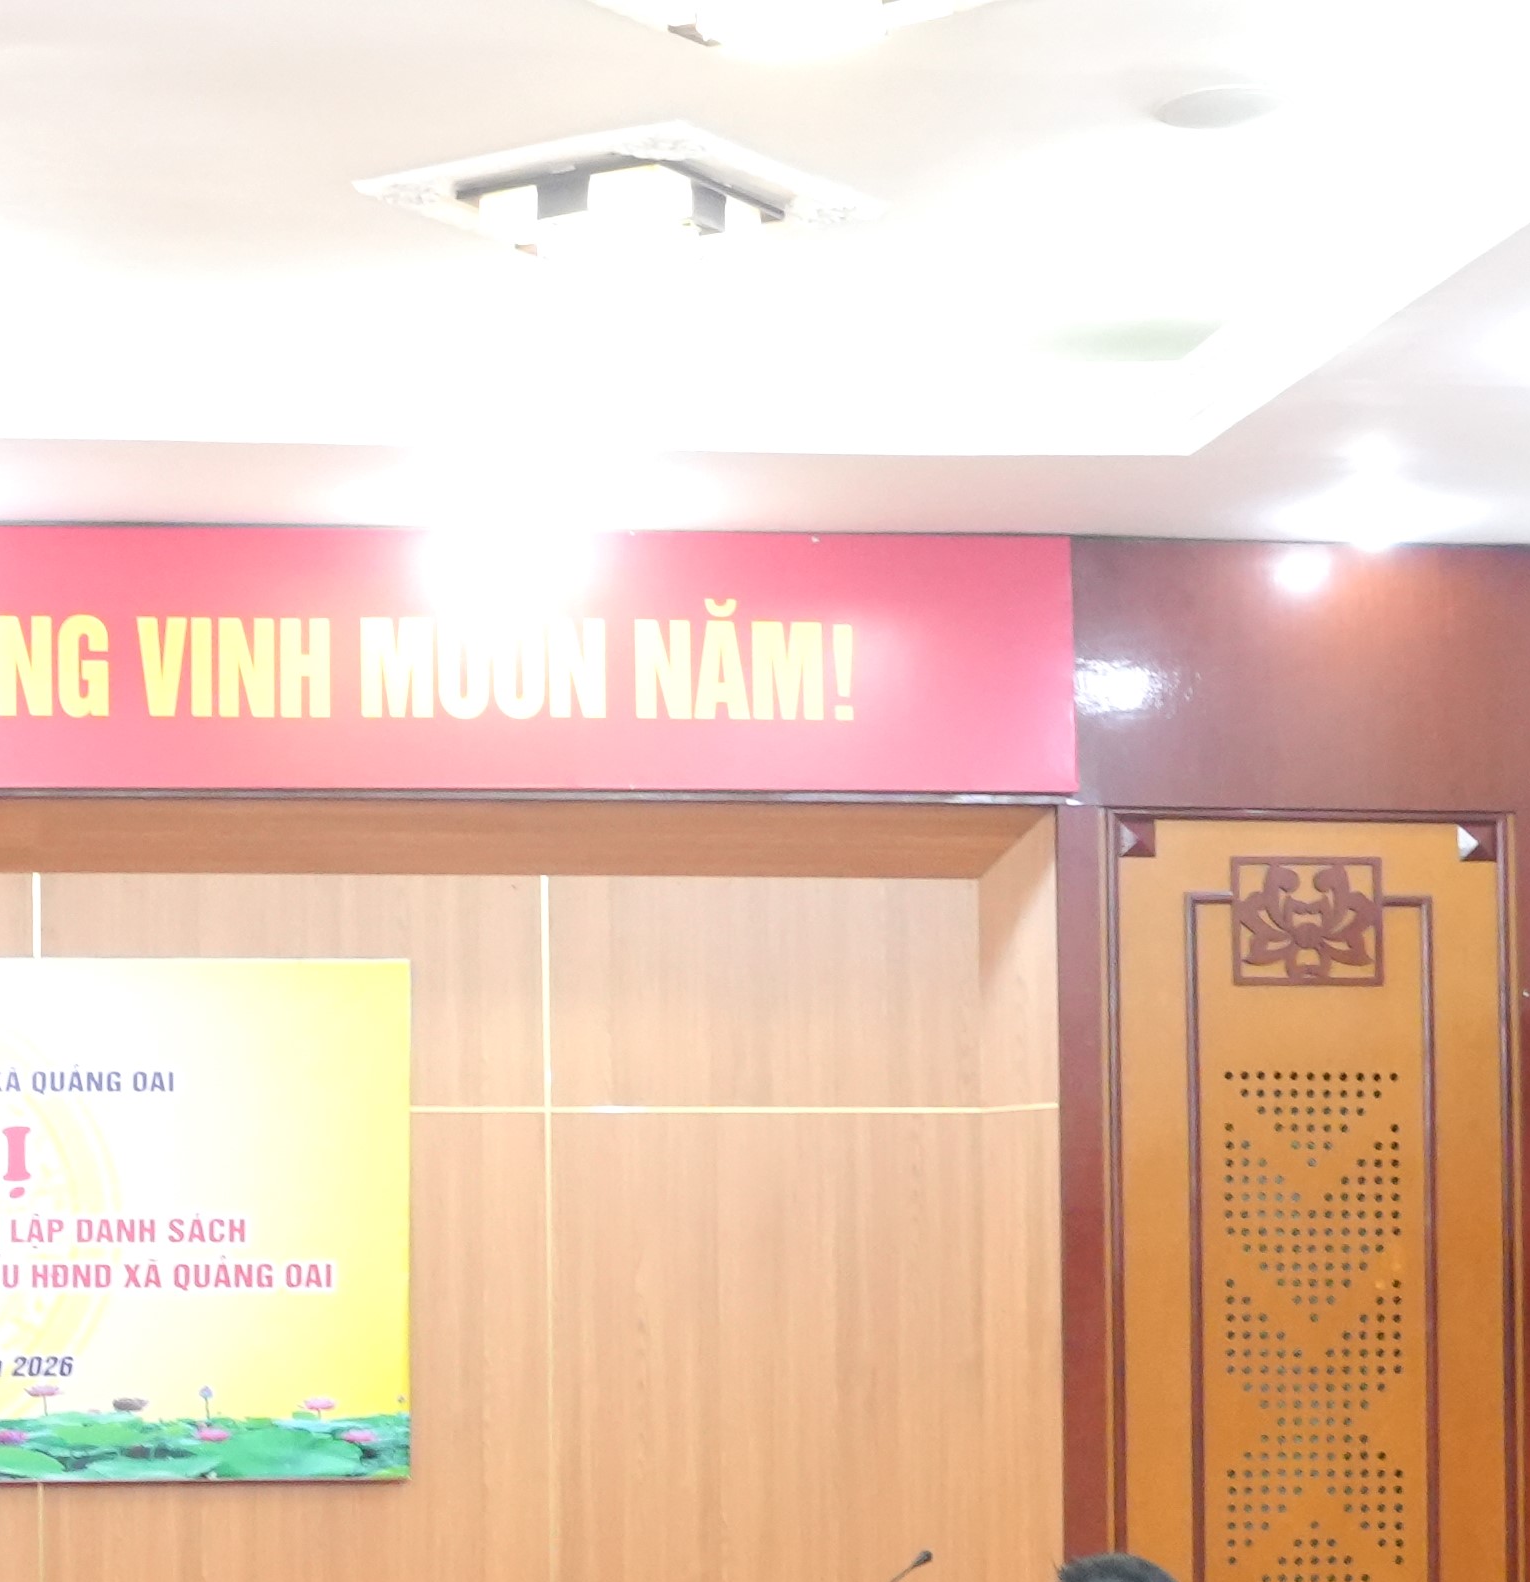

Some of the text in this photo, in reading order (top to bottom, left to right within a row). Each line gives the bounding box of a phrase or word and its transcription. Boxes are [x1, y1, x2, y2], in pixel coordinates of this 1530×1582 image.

[136, 615, 332, 719] VINH
[634, 597, 856, 722] NĂM!
[31, 1063, 122, 1096] QUẢNG
[132, 1070, 175, 1093] OAI
[10, 1213, 65, 1249] LẬP
[76, 1218, 157, 1244] DANH
[167, 1212, 247, 1244] SÁCH
[31, 1263, 113, 1289] HĐND
[172, 1254, 274, 1292] QUẢNG
[284, 1263, 333, 1289] OAI
[10, 1355, 75, 1378] 2026
